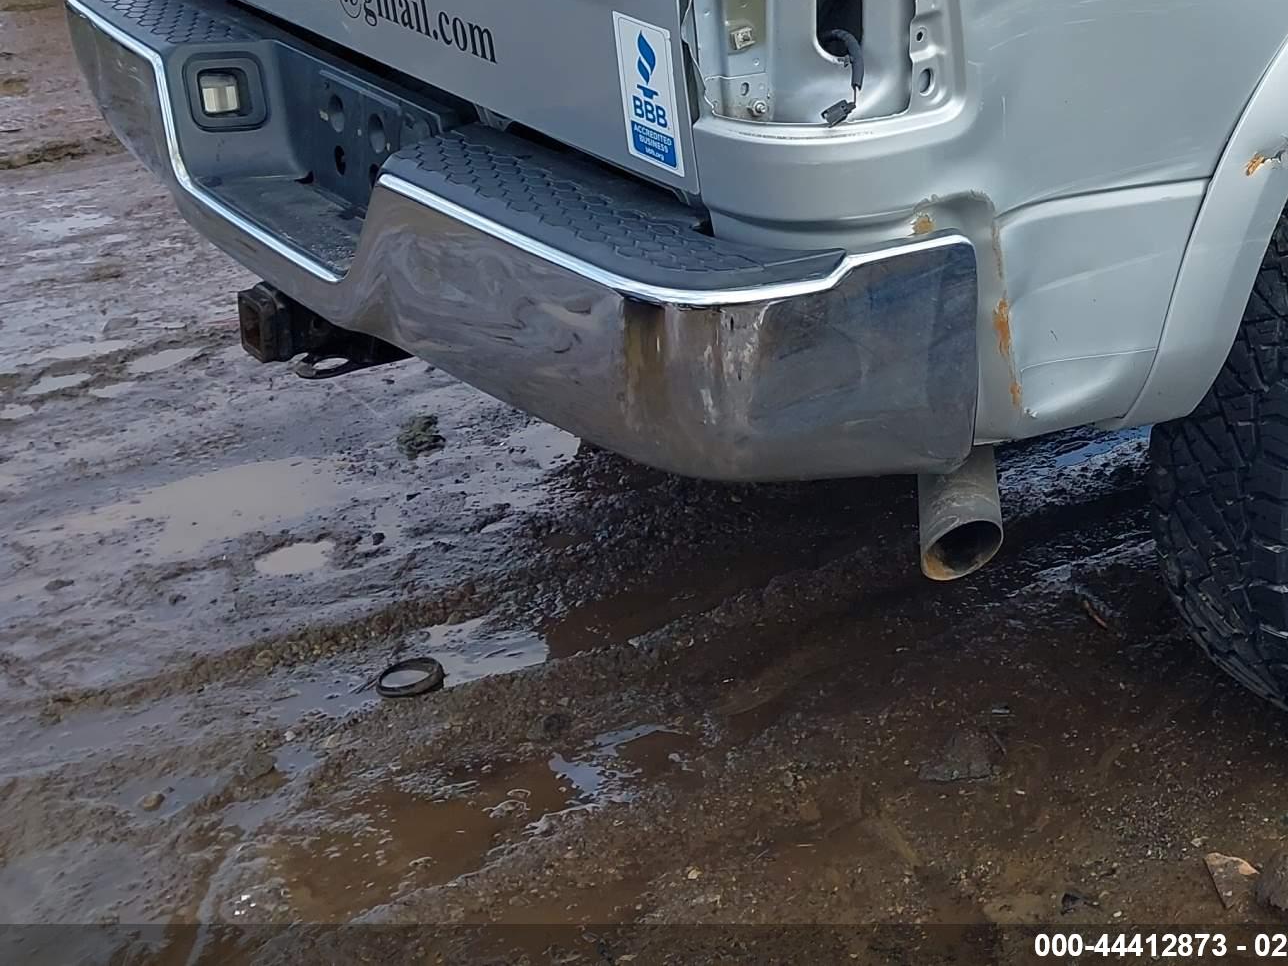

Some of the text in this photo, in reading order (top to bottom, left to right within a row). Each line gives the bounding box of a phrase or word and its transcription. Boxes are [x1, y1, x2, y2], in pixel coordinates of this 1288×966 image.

[632, 95, 669, 129] BBB
[633, 123, 673, 146] ACCREDITED
[638, 134, 669, 153] BUSINESS
